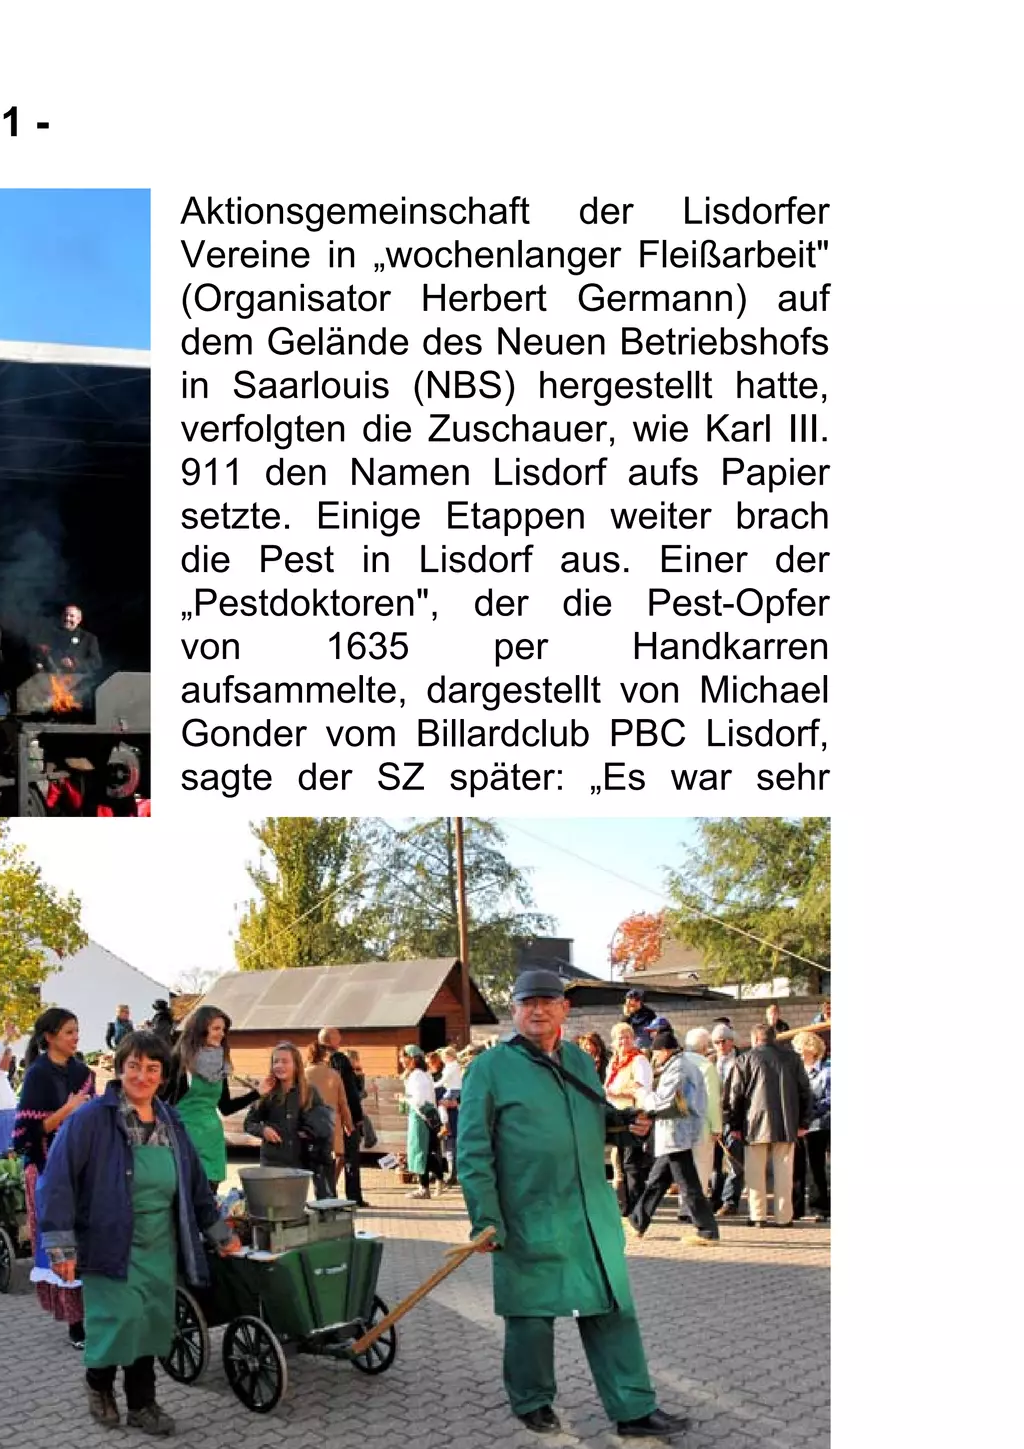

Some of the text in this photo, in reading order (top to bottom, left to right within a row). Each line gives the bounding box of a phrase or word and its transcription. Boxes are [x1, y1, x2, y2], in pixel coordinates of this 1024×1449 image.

[36, 121, 50, 130] -
[180, 195, 831, 233] Aktionsgemeinschaft der Lisdorfer
[180, 239, 829, 276] Vereine in „wochenlanger Fleißarbeit"
[182, 282, 832, 320] (Organisator Herbert Germann) auf
[182, 369, 827, 407] in Saarlouis (NBS) hergestellt hatte,
[180, 413, 828, 450] verfolgten die Zuschauer, wie Karl III.
[181, 456, 831, 494] 911 den Namen Lisdorf aufs Papier
[181, 543, 831, 574] die Pest in Lisdorf aus. Einer der
[181, 587, 831, 624] „Pestdoktoren", der die Pest-Opfer
[180, 631, 828, 668] von 1635 per Handkarren
[181, 718, 827, 752] Gonder vom Billardclub PBC Lisdorf,
[181, 761, 831, 799] sagte der SZ später: „Es war sehr
